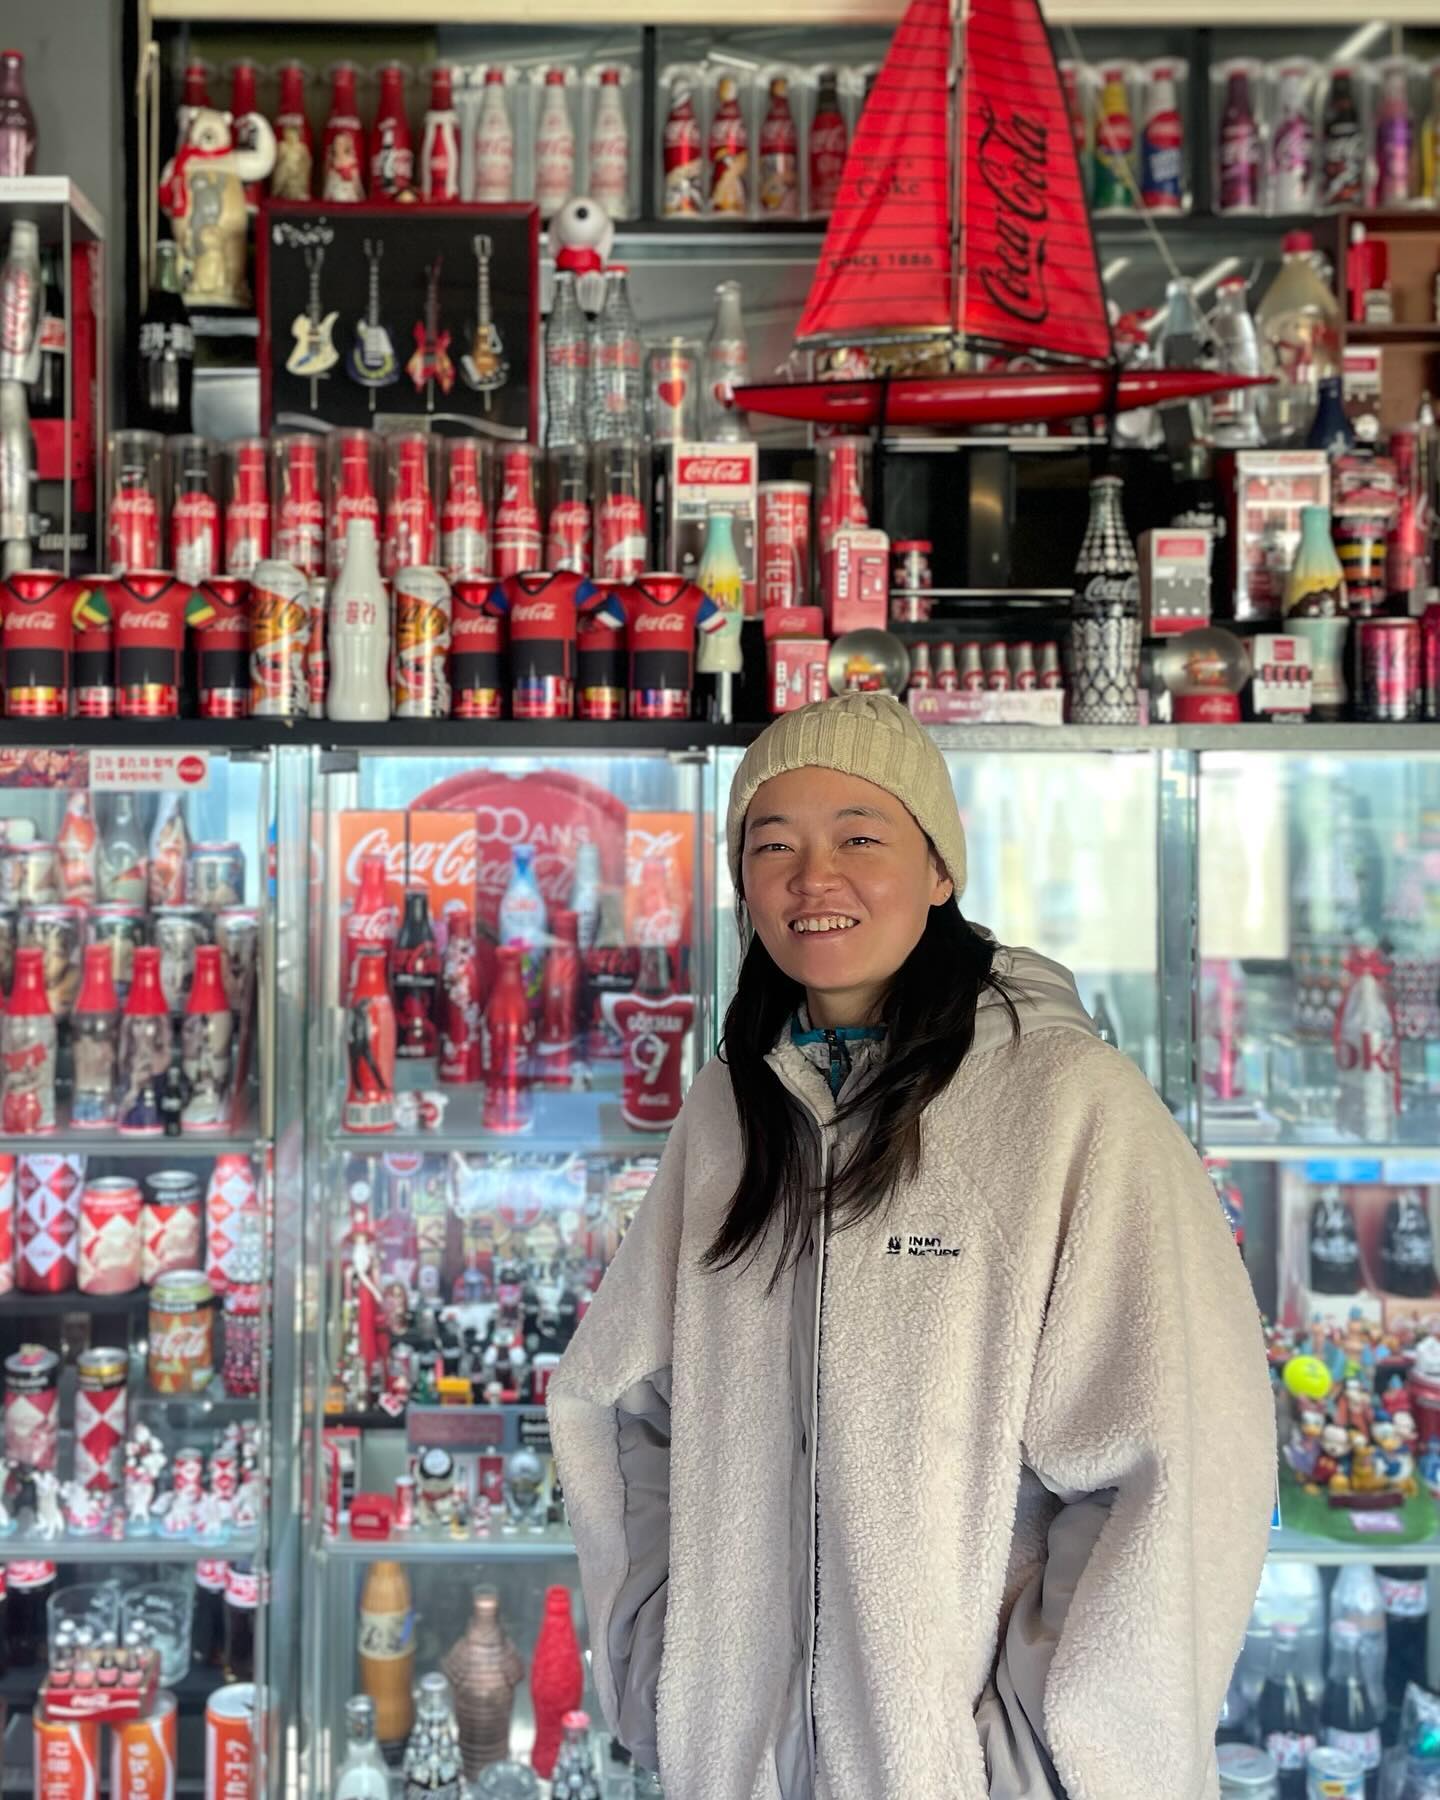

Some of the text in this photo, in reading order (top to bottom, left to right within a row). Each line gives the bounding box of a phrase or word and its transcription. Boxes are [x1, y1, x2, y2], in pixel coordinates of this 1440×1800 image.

[979, 97, 1049, 323] Coca-Cola
[683, 459, 743, 482] Coca-Cola
[5, 611, 55, 630] Coca-Cola
[119, 610, 169, 629] Coca-Cola
[510, 603, 556, 621] Coca-Cola
[452, 616, 499, 634] Coca-Cola
[635, 613, 685, 632] Coca-Cola
[531, 823, 591, 846] ANS
[631, 1033, 669, 1084] 9
